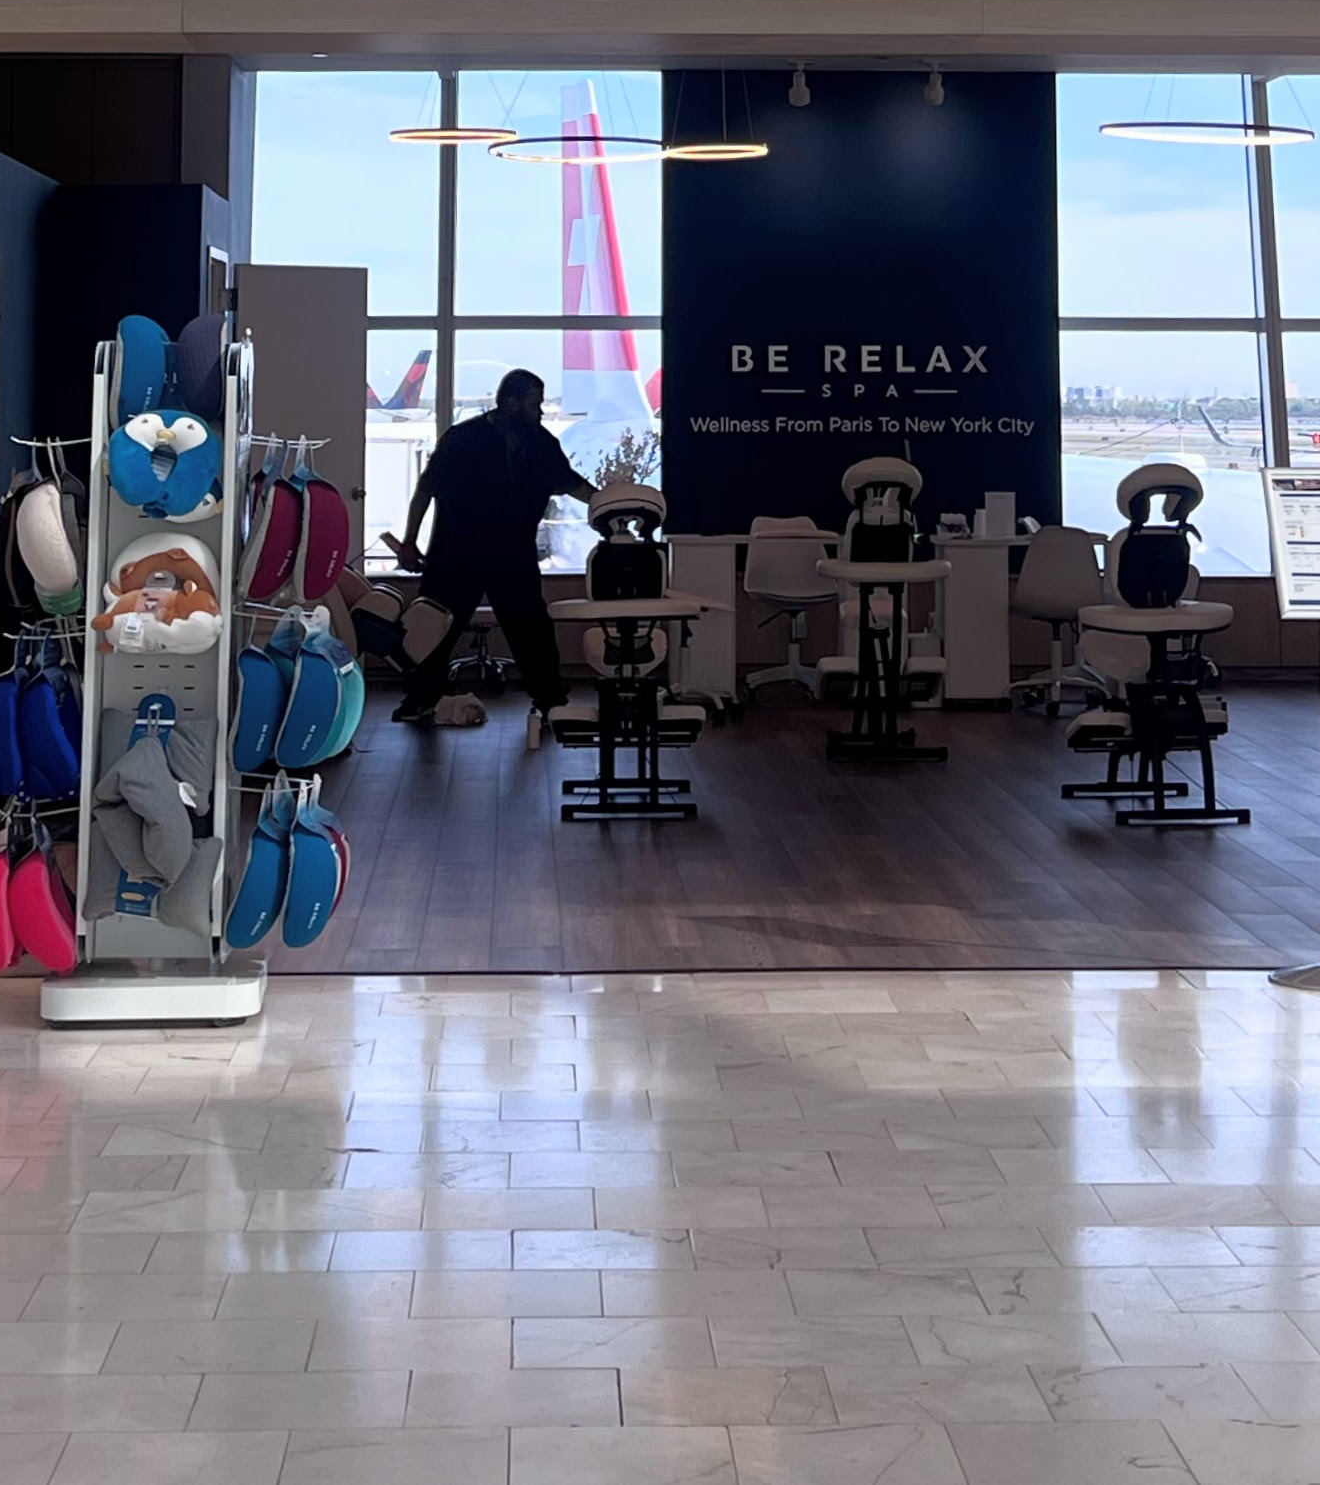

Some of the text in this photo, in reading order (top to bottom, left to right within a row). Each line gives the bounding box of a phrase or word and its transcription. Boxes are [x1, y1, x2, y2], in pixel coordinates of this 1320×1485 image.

[731, 344, 989, 373] BE RELAX
[821, 383, 899, 398] SPA
[690, 416, 1035, 436] Wellness From Paris To New York City
